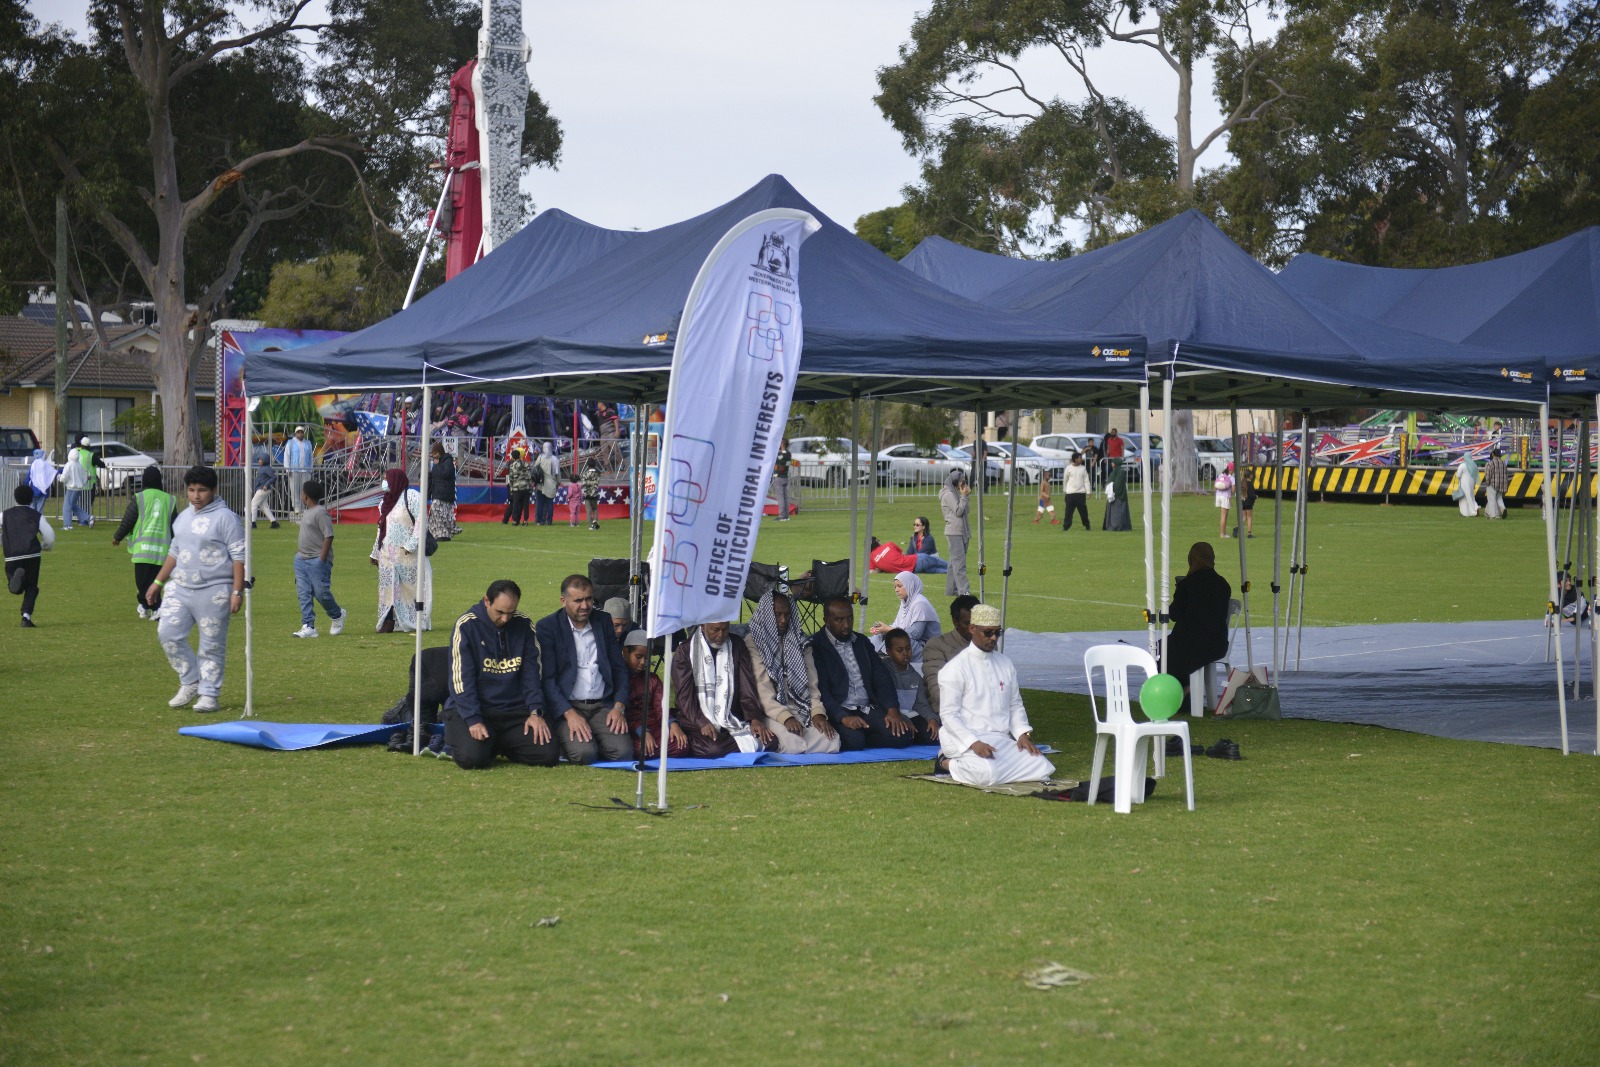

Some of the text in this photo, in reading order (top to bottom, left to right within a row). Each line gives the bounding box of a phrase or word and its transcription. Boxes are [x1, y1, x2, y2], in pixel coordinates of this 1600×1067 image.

[748, 276, 796, 295] WESTERN AUSTRALIA
[753, 271, 785, 286] GOVERNMENT
[723, 371, 784, 599] MULTICULTURAL INTERESTS
[705, 512, 733, 597] OFFICE OF
